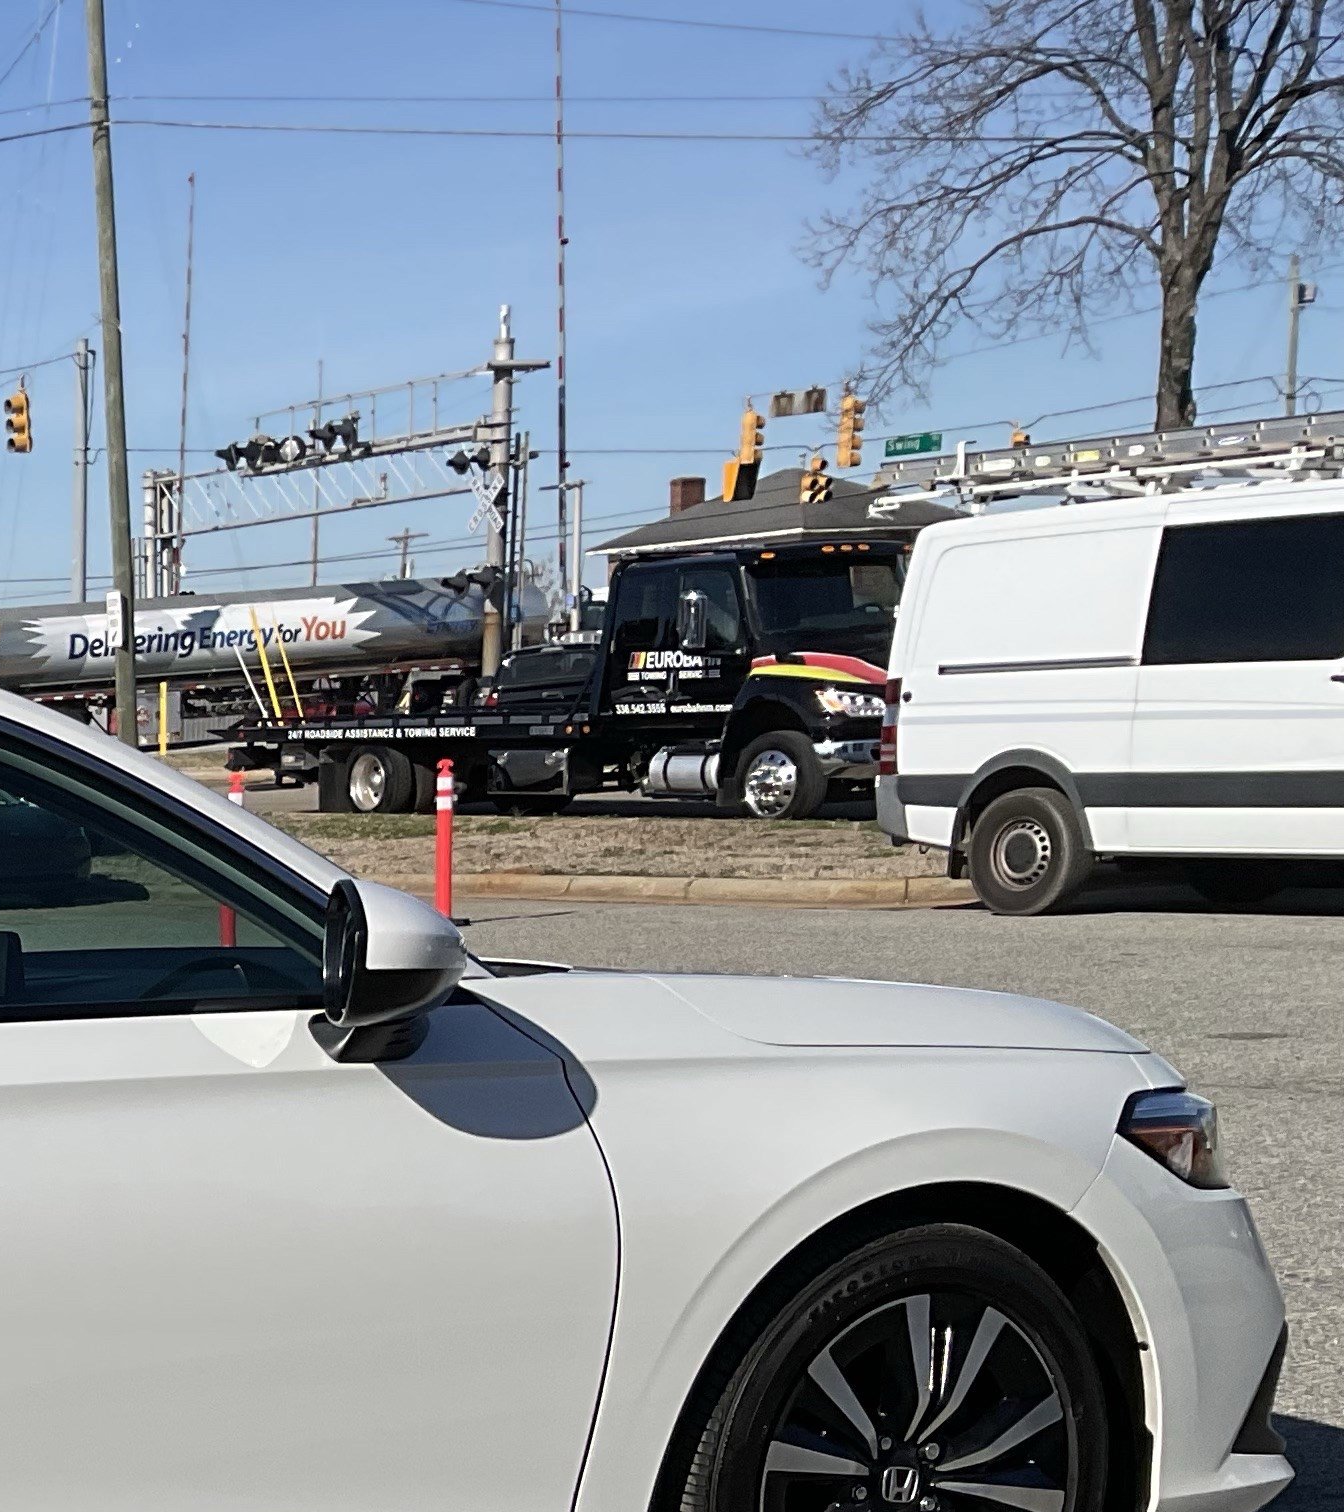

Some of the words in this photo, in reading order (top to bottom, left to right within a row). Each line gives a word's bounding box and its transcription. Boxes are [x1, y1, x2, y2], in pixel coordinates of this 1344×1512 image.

[198, 626, 274, 651] Energy
[275, 624, 302, 643] for
[301, 616, 347, 642] You
[304, 729, 344, 739] ROADSIDE
[344, 728, 394, 739] ASSISTANCE
[403, 727, 438, 738] TOWING
[438, 726, 477, 738] SERVICE
